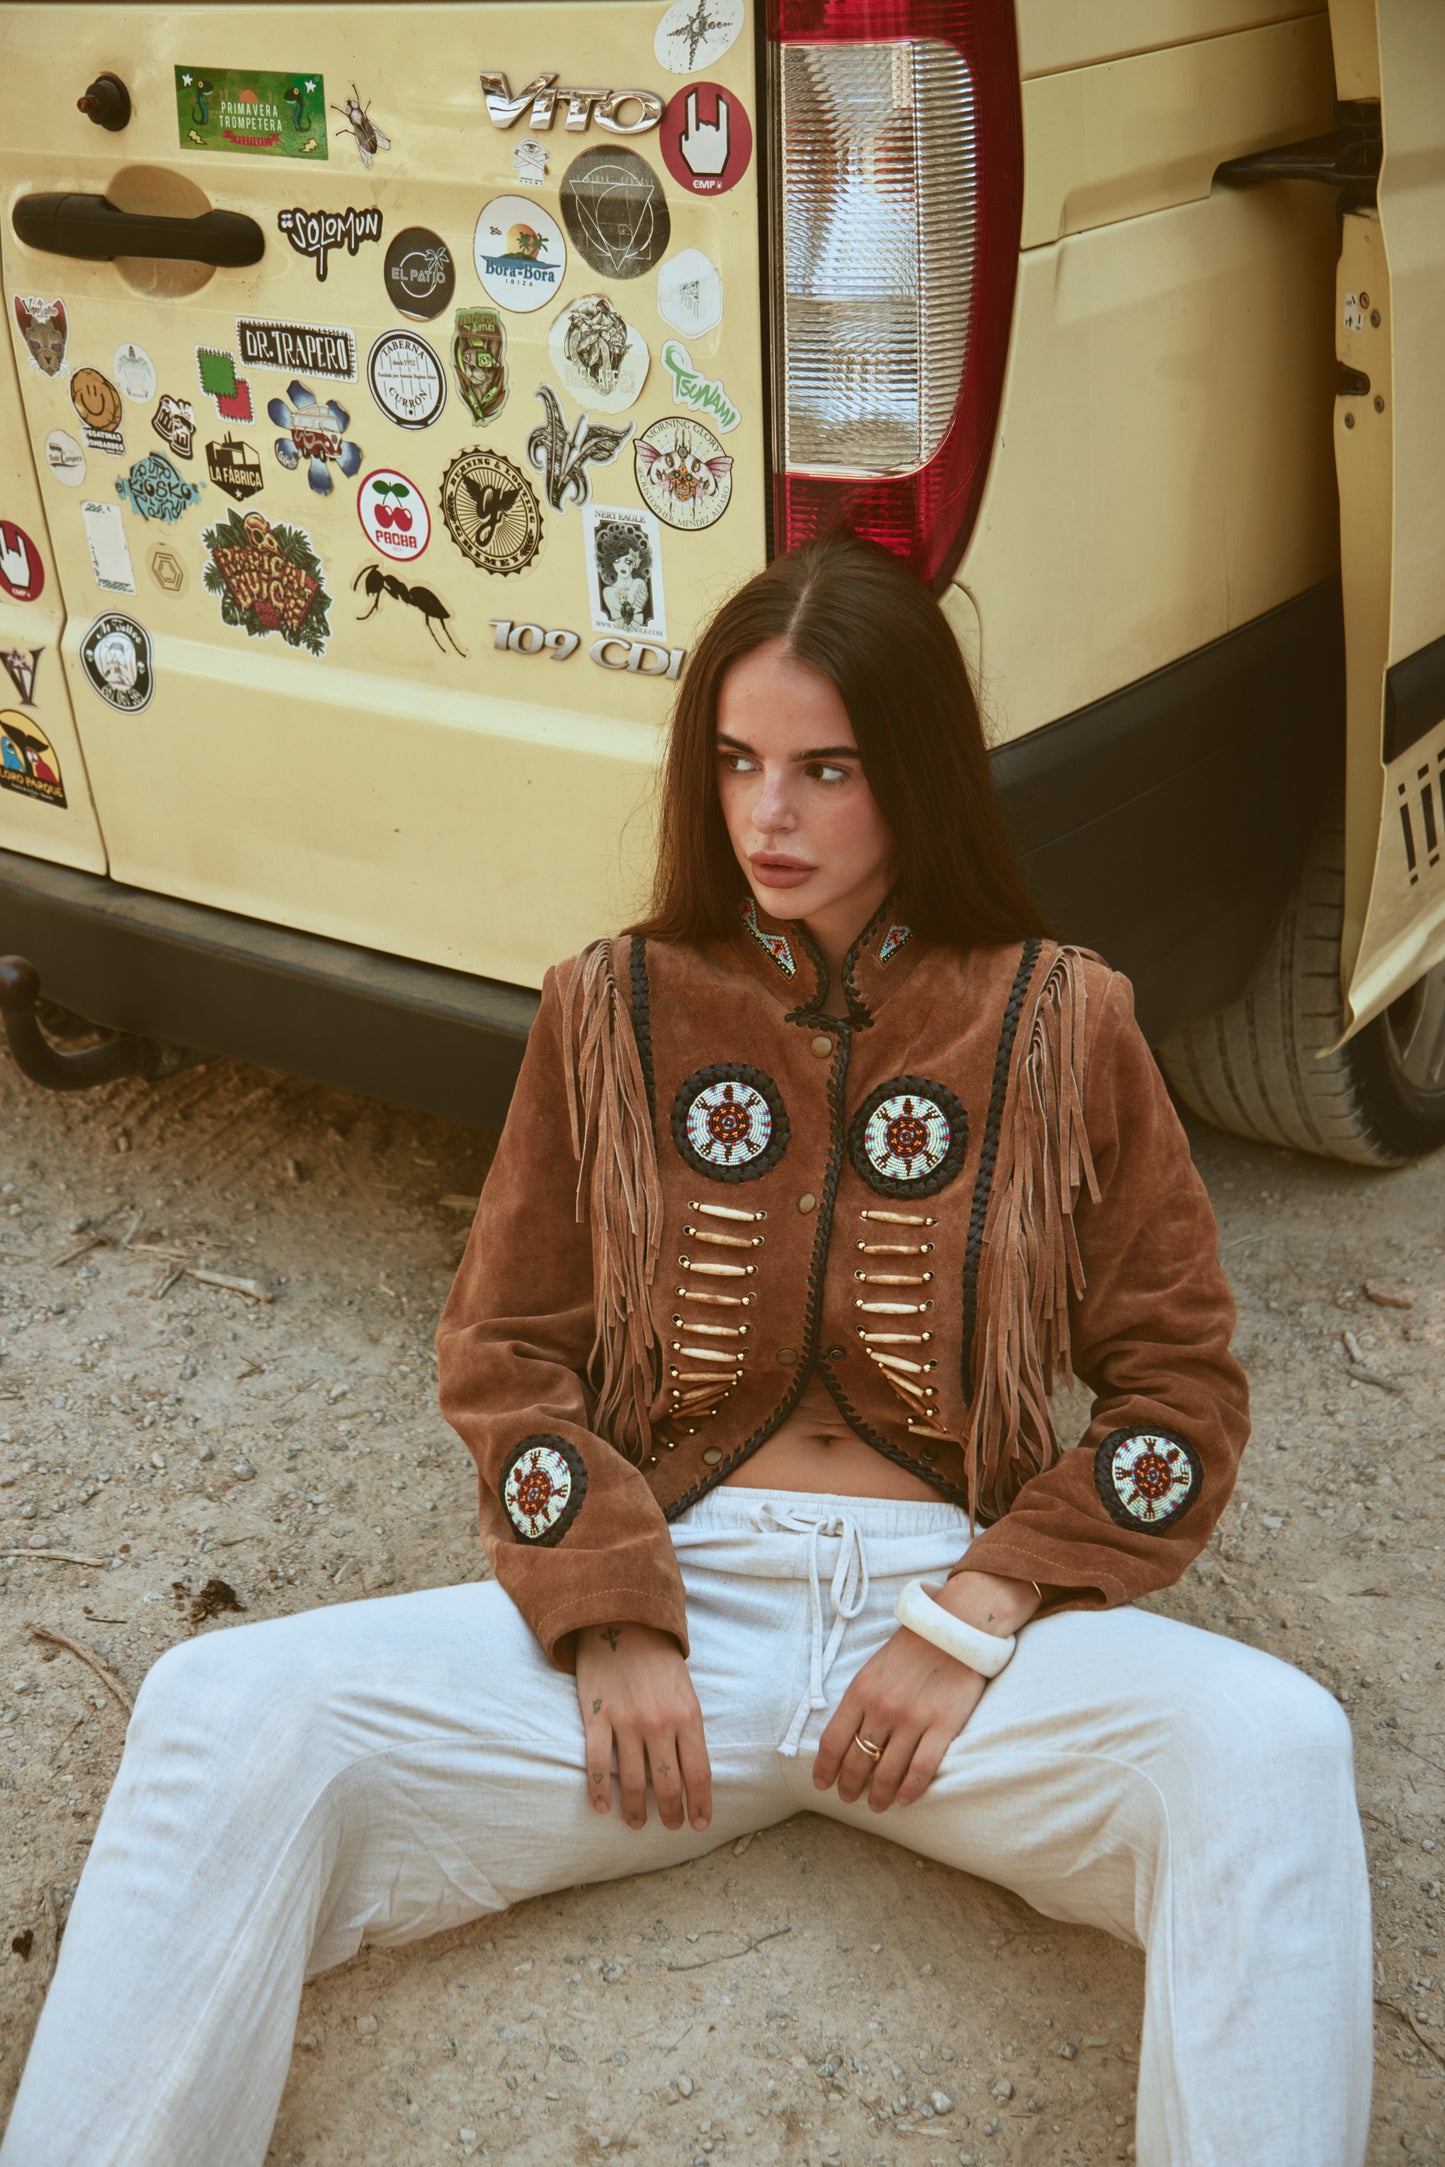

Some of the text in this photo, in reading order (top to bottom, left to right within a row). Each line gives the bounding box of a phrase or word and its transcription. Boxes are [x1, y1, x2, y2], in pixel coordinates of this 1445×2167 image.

[221, 101, 278, 118] PRIMAVERA
[479, 71, 667, 134] VITO
[219, 115, 283, 132] TROMPETERA
[692, 180, 717, 190] EMP
[290, 211, 379, 275] SOLOMUN
[391, 266, 446, 285] EL PATIO
[485, 259, 555, 283] Bora-Bora
[505, 278, 533, 287] IBIZA
[245, 328, 349, 370] DR. TRAPERO
[381, 340, 424, 360] TABERNA
[388, 386, 428, 408] CURRÓN
[665, 345, 736, 428] TSUNAMI
[646, 419, 721, 453] MORNING GLORY
[209, 464, 263, 487] LA FÁBRICA
[450, 458, 536, 524] BURNING & LOOTING
[594, 510, 646, 524] NERY EAGLE
[677, 515, 710, 528] MENDEZ
[711, 485, 730, 518] ALFARO
[375, 530, 418, 549] PACHA
[454, 525, 520, 567] GRIMEY
[488, 620, 687, 680] 109 CDI
[25, 776, 63, 799] PARQUE
